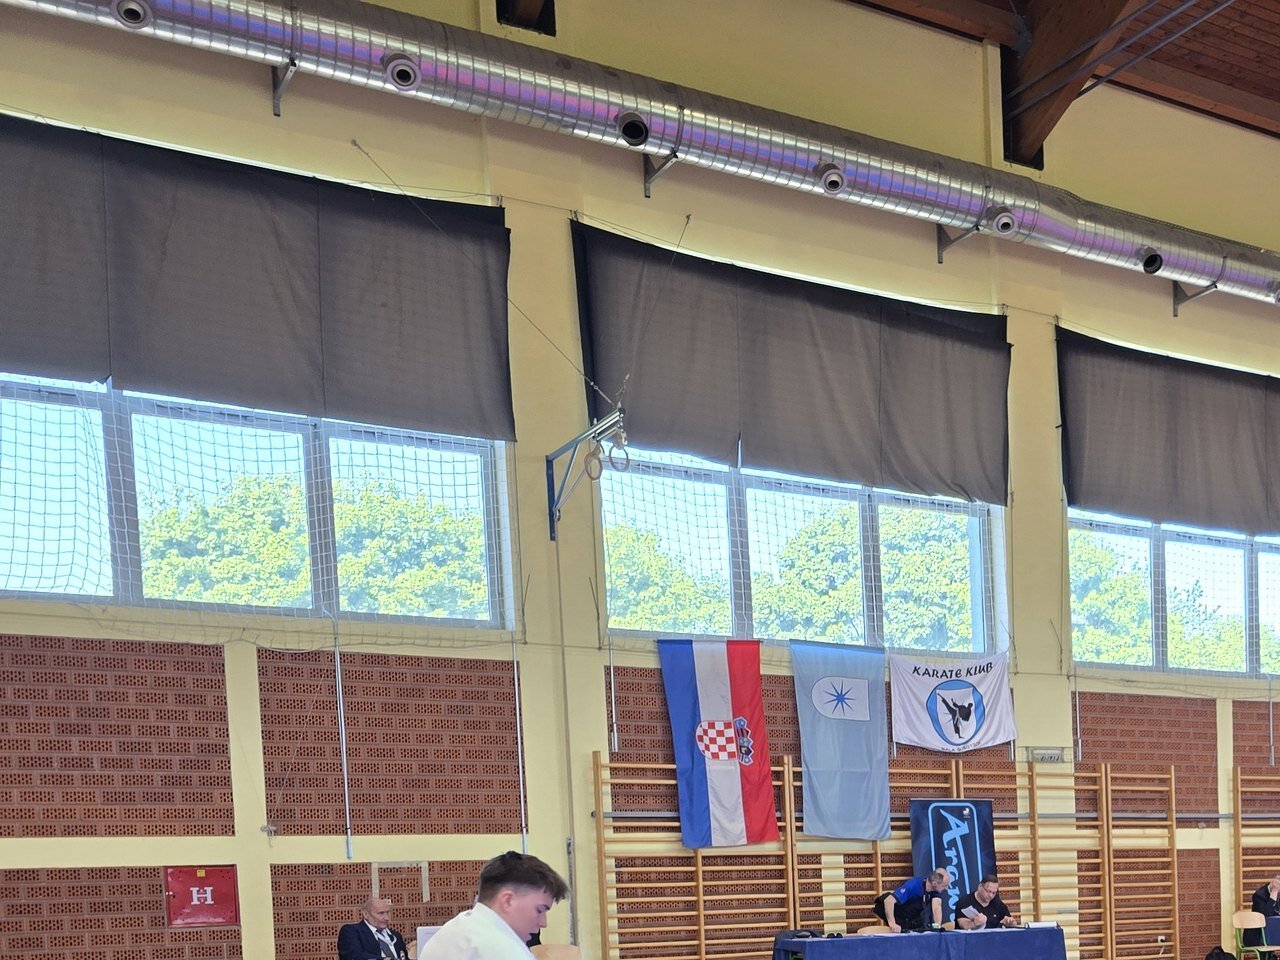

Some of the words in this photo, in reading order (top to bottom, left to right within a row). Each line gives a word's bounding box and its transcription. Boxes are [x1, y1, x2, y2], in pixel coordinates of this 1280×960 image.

[912, 666, 962, 679] KARATE
[965, 661, 994, 677] KLUB
[189, 886, 215, 905] H
